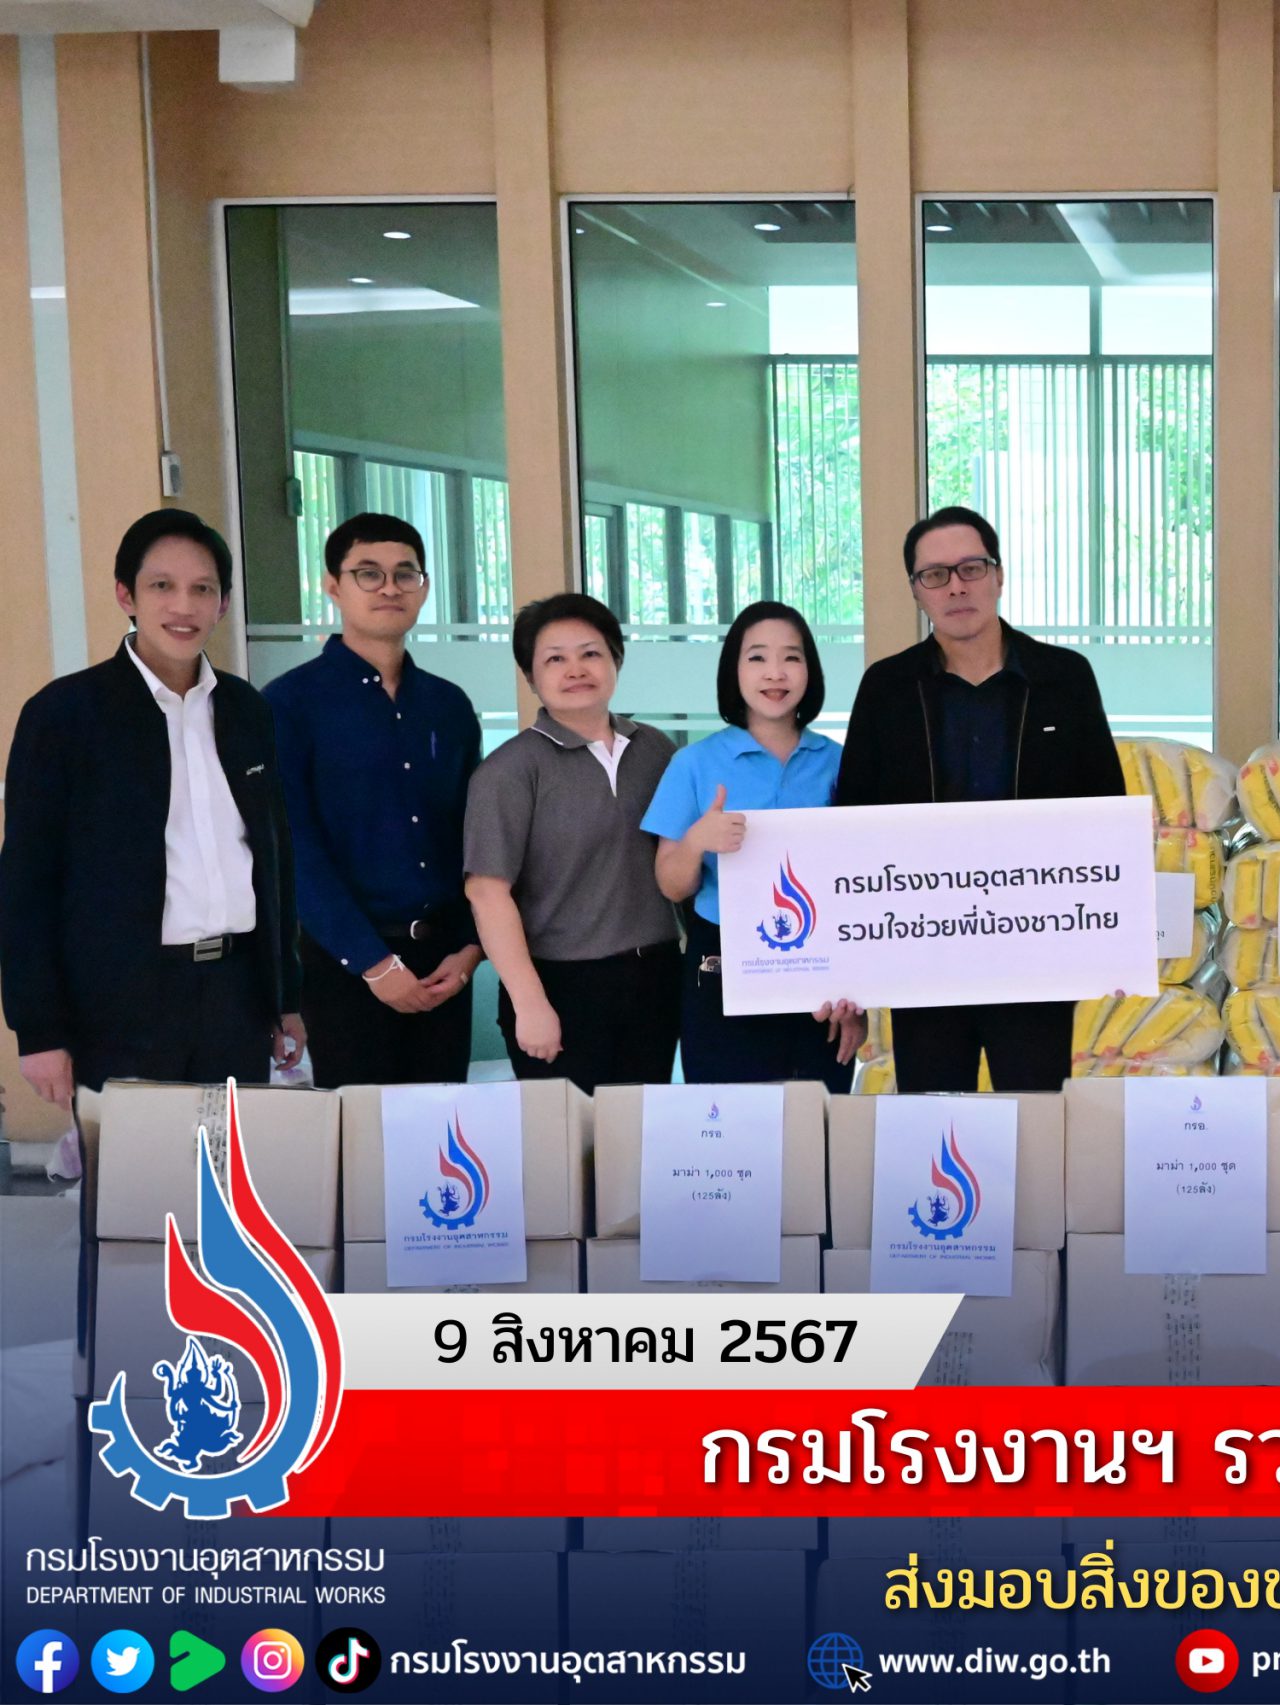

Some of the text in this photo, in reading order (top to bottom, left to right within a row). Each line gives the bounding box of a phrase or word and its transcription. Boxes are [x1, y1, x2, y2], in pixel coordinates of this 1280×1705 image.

[834, 861, 1121, 896] กรมโรงงานอุตสาหกรรม
[837, 903, 1119, 942] รวมใจช่วยพี่น้องชาวไทย
[672, 1166, 752, 1181] มาม่า 1,000 ชุด
[1156, 1159, 1236, 1175] มาม่า 1,000 ชุด
[692, 1189, 732, 1202] (125ลัง)
[1176, 1182, 1216, 1195] (125ลัง)
